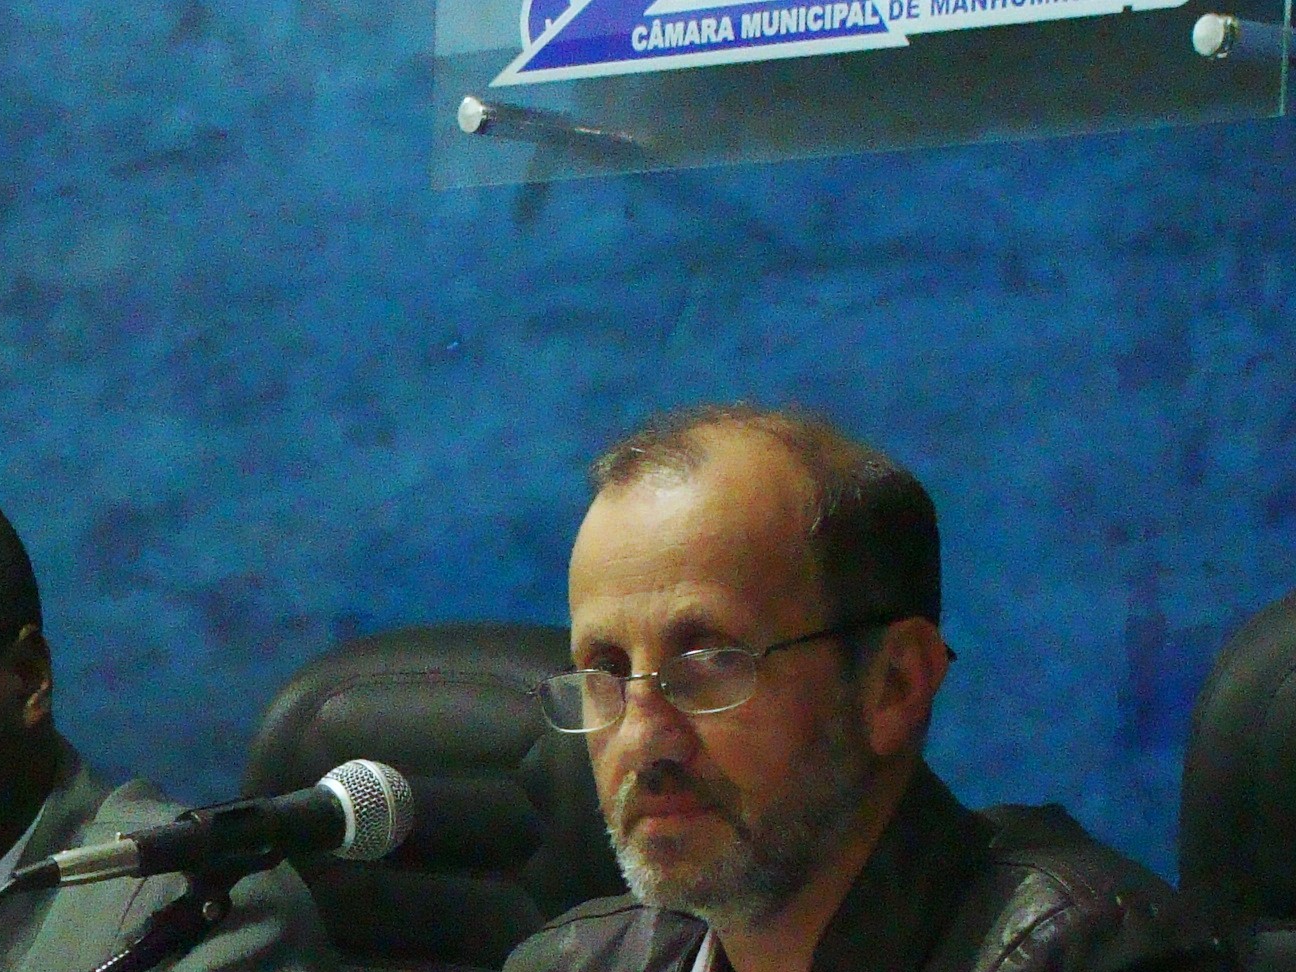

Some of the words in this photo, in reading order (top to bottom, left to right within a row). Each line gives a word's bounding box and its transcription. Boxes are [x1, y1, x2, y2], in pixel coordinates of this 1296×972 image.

[631, 18, 734, 51] CÂMARA
[740, 4, 880, 39] MUNICIPAL
[888, 0, 920, 21] DE
